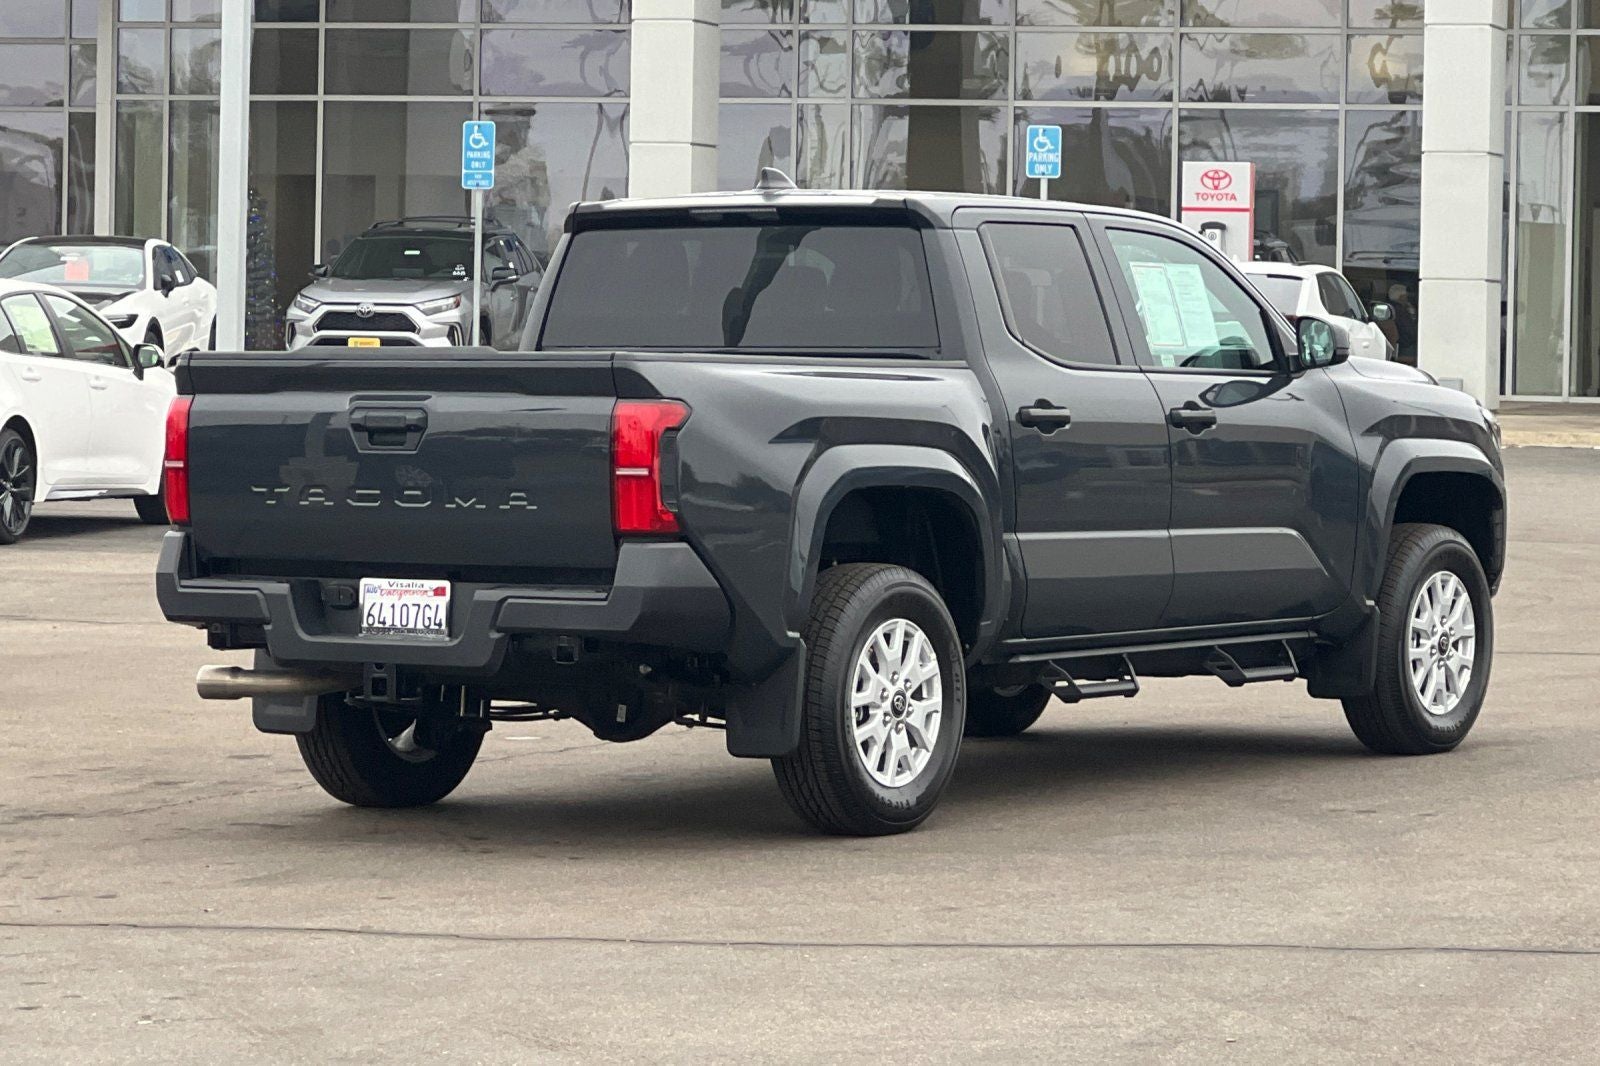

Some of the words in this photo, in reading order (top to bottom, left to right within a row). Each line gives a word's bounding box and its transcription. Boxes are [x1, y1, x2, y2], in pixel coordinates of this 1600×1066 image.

[466, 150, 491, 159] PARKING
[1028, 152, 1060, 163] PARKING
[471, 160, 486, 169] ONLY
[1034, 163, 1053, 175] ONLY
[1195, 192, 1237, 201] TOYOTA
[250, 485, 538, 510] TACOMA
[387, 580, 425, 588] Visalia
[366, 602, 443, 629] 64107G4
